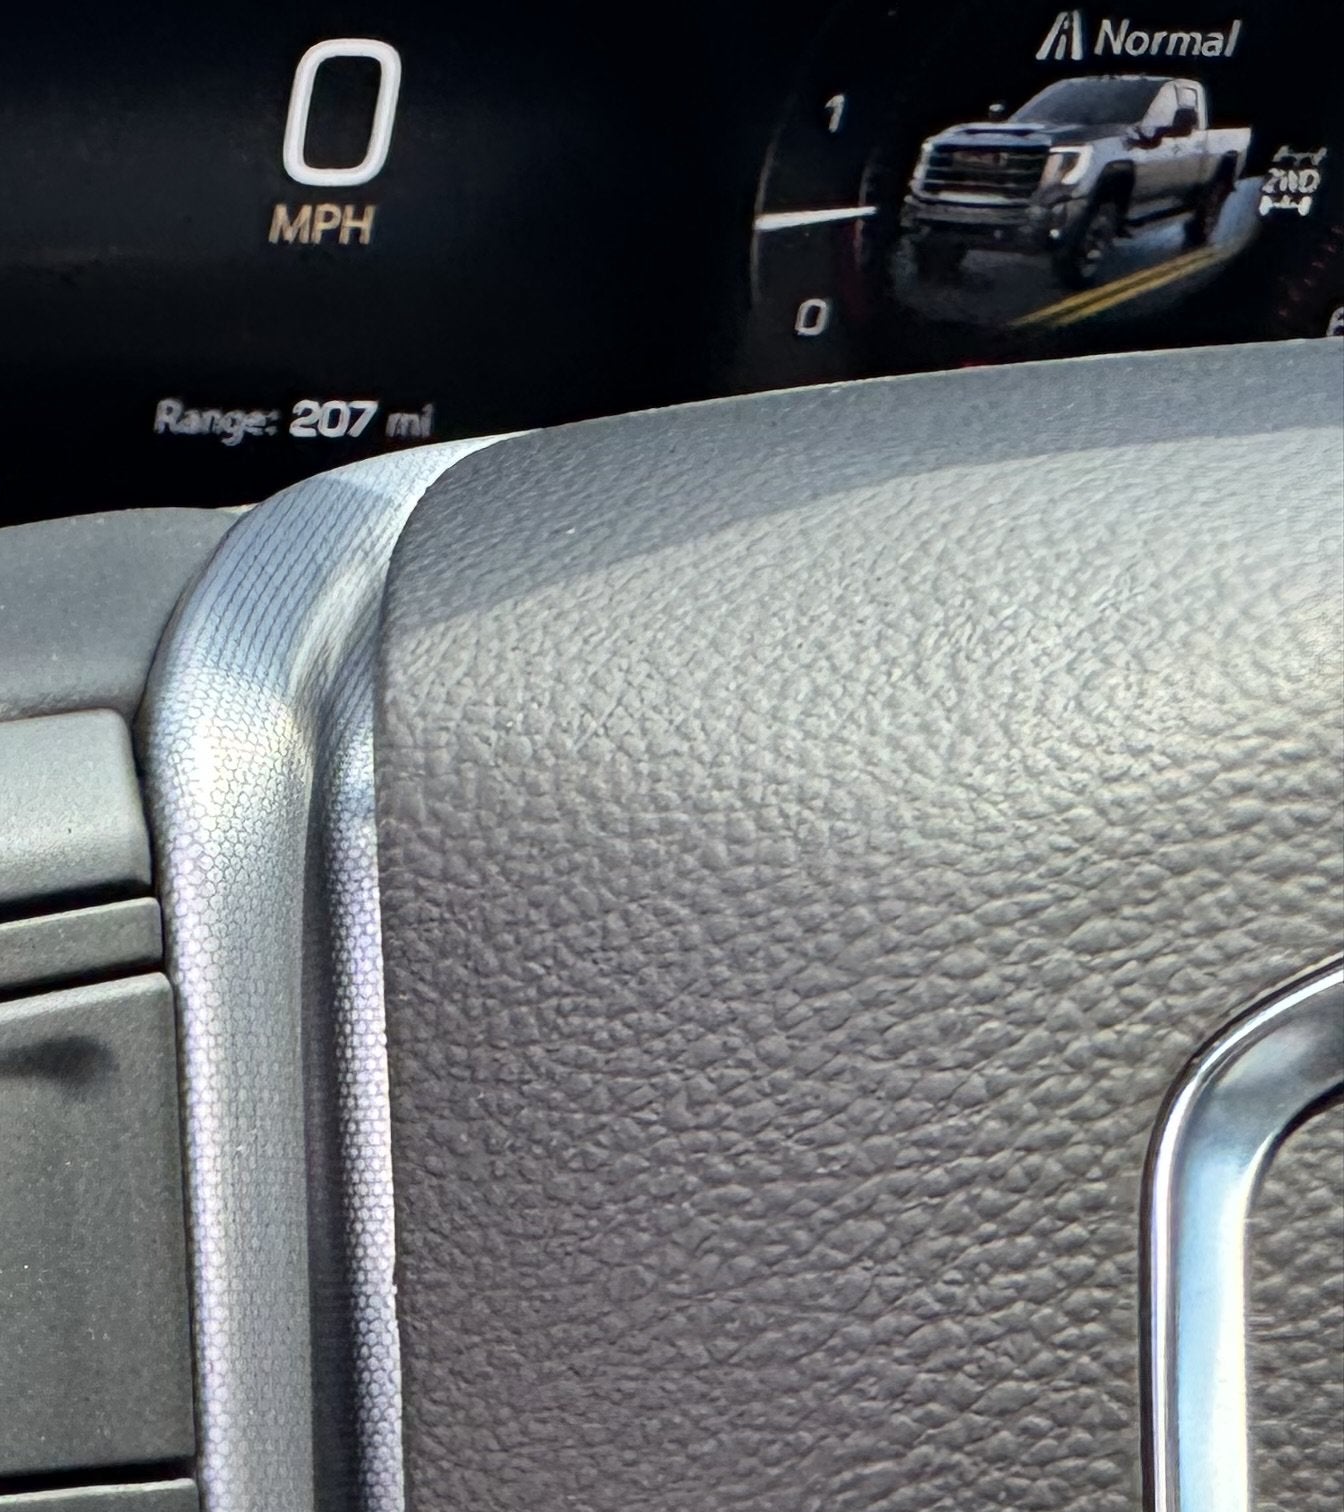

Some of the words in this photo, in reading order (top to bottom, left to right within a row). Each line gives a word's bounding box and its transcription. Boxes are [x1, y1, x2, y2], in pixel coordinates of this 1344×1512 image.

[1094, 19, 1243, 58] Normal
[282, 38, 402, 187] 0
[824, 93, 846, 134] 1
[268, 202, 376, 245] MPH
[794, 298, 830, 337] 0
[154, 398, 280, 446] Range:
[288, 399, 378, 438] 207
[385, 404, 434, 438] mi
